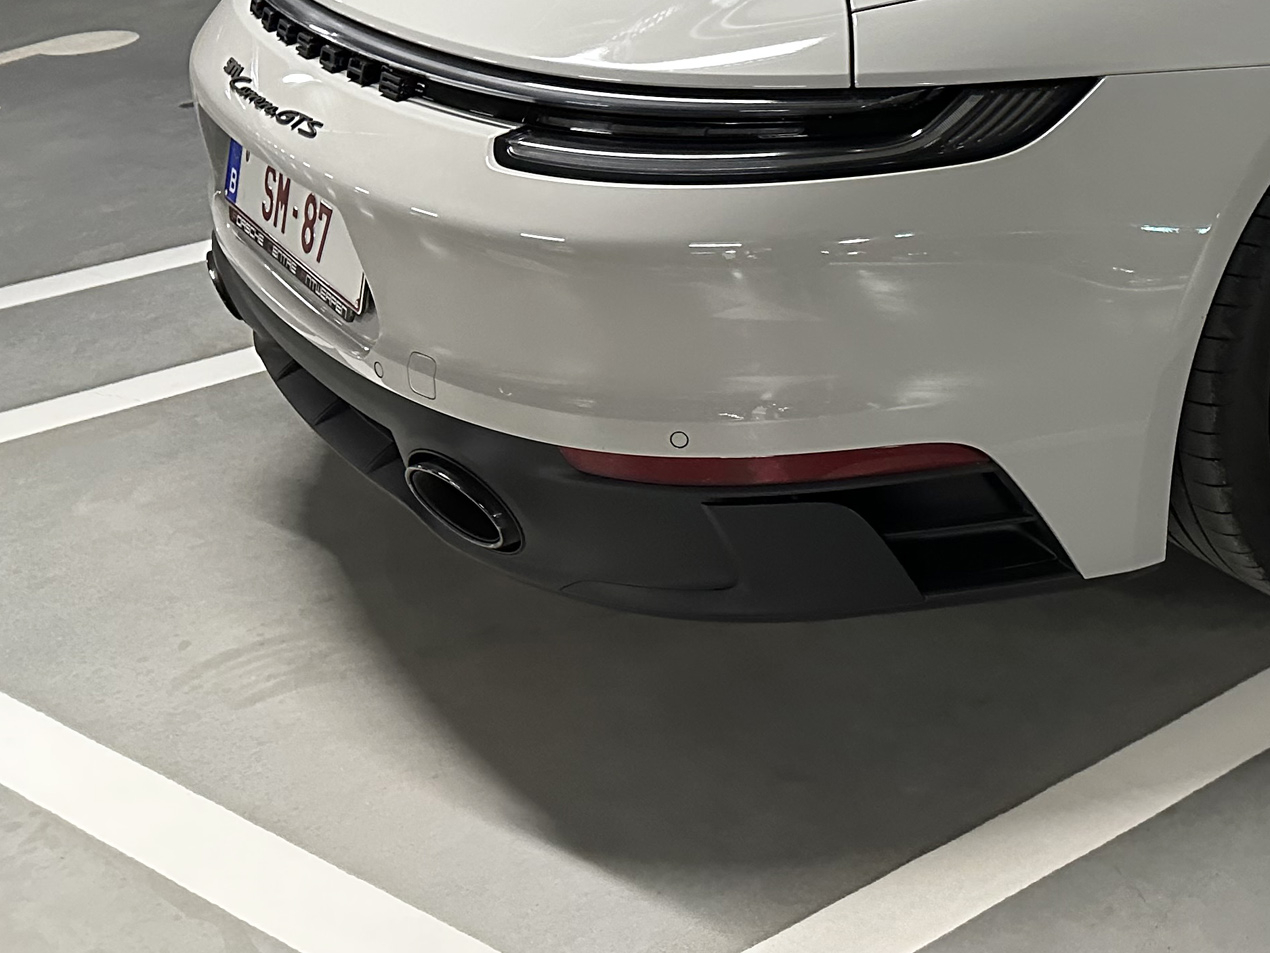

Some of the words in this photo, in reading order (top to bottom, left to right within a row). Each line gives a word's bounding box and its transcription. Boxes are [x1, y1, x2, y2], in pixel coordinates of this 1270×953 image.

[229, 76, 279, 119] Carrera
[275, 110, 324, 139] GTS
[229, 167, 238, 194] B
